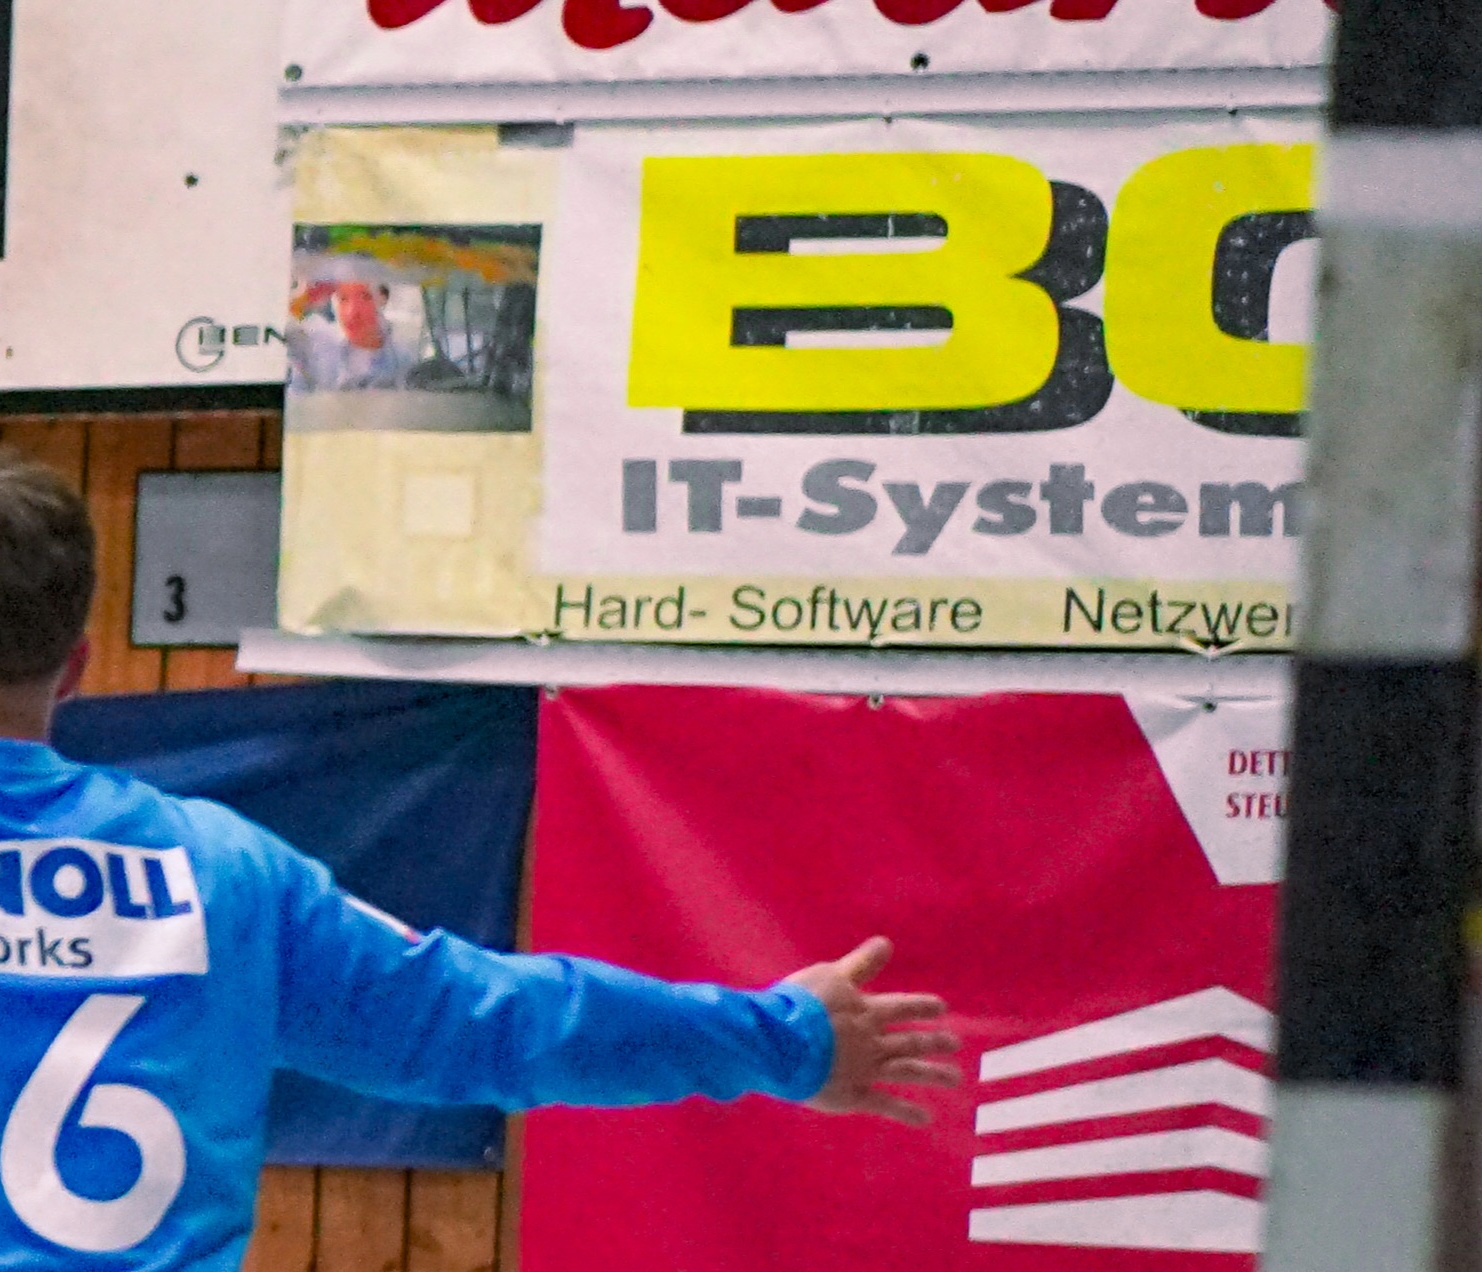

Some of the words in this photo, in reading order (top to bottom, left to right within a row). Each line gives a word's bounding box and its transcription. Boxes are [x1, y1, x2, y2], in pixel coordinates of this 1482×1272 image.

[163, 575, 185, 623] 3
[553, 583, 708, 634] Hard-
[728, 583, 983, 644] Software
